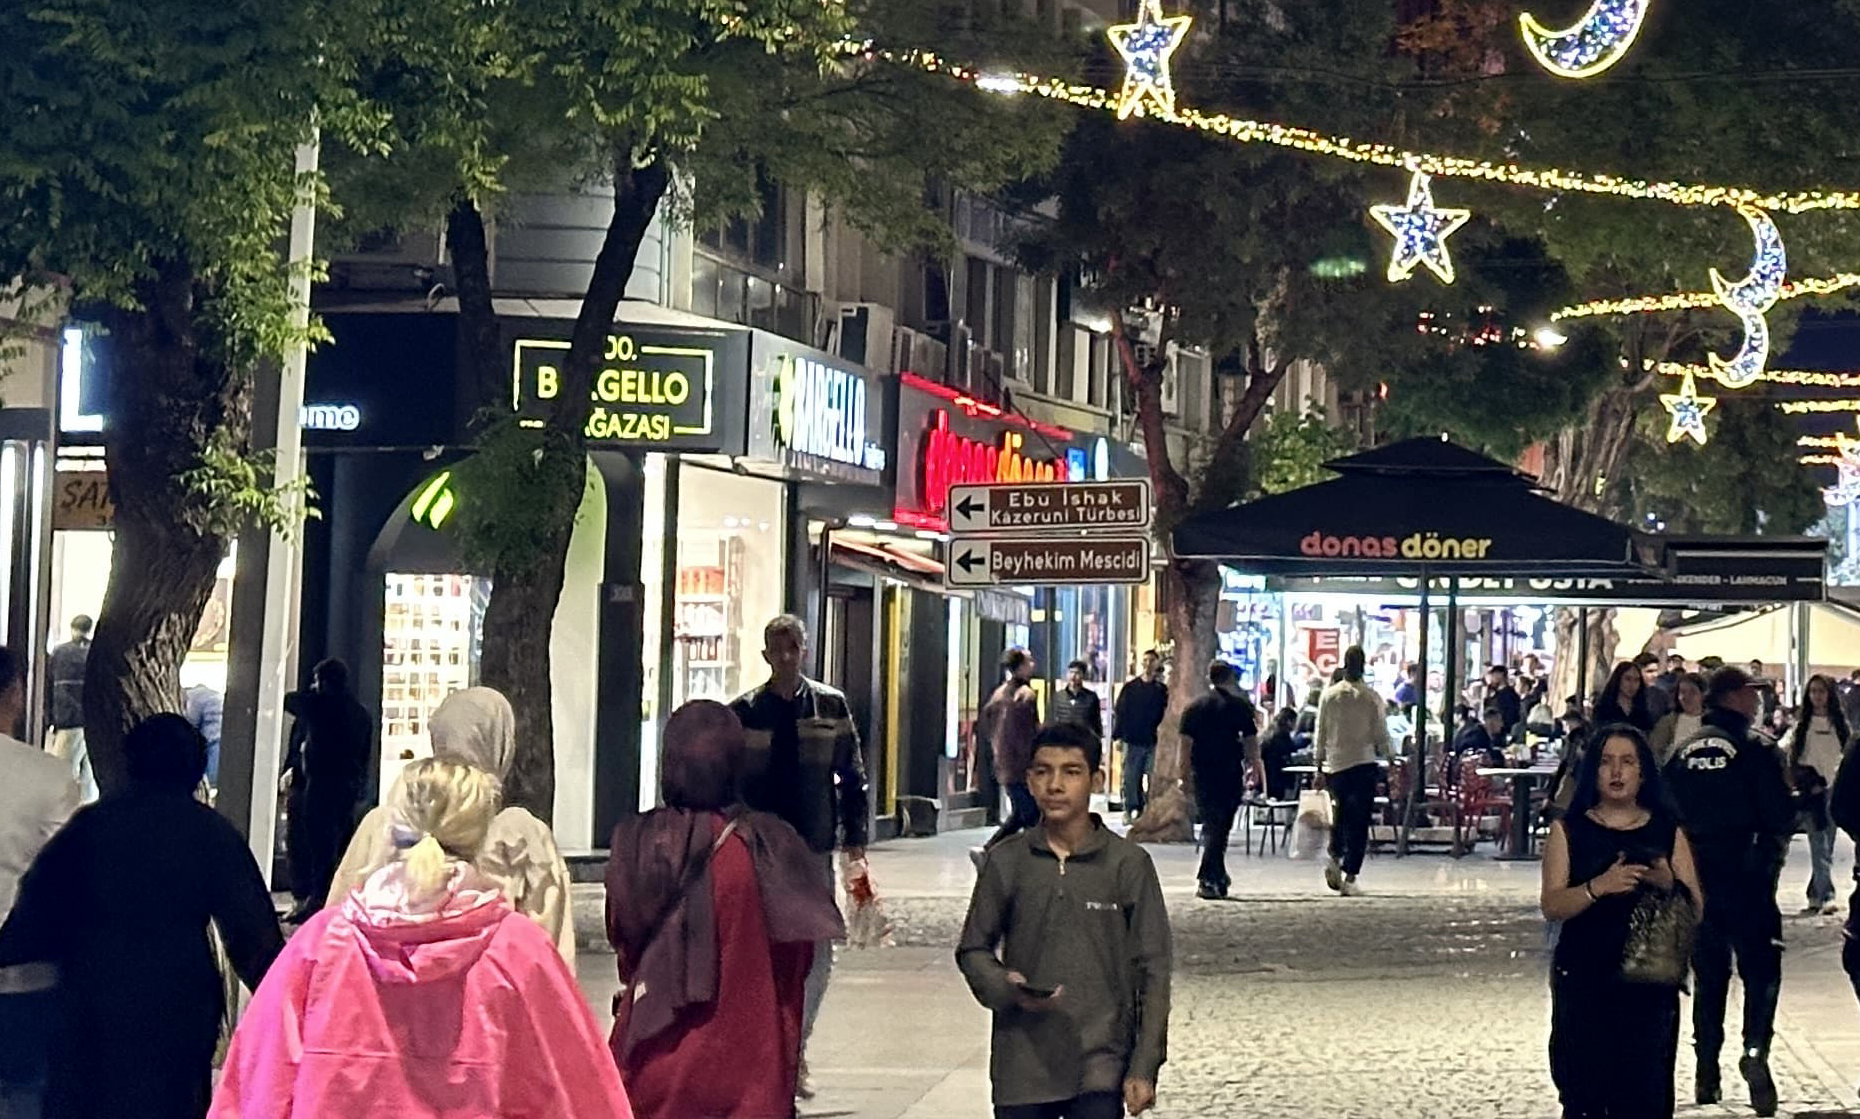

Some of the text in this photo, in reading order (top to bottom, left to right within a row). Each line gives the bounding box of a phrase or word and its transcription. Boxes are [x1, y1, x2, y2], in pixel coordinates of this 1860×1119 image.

[538, 366, 689, 405] BGELLO
[584, 408, 670, 440] ĞAZASI
[1300, 532, 1492, 558] donas döner
[992, 549, 1140, 575] Beyhekim Mescidi
